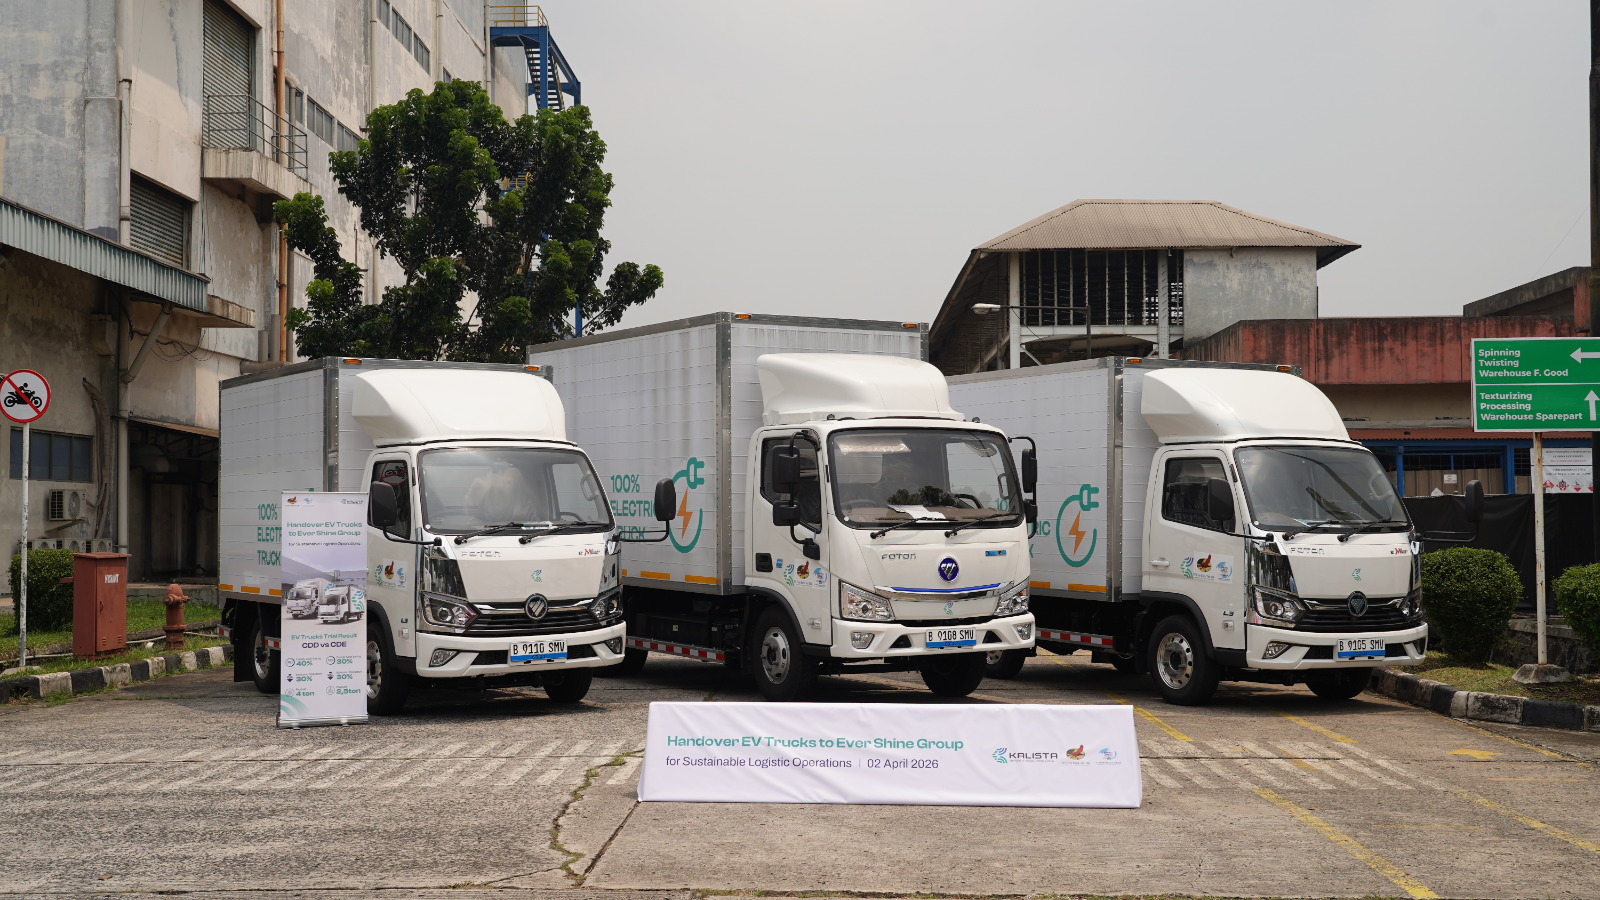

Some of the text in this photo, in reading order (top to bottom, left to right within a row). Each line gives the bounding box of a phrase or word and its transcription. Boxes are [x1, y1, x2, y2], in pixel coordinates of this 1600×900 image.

[1478, 348, 1521, 358] Spinning
[1478, 358, 1519, 368] Twisting
[1479, 368, 1569, 377] Warehouse F. Good
[1479, 392, 1533, 401] Texturizing
[1480, 402, 1532, 411] Processing
[1481, 412, 1583, 421] Warehouse Sparepart
[610, 474, 640, 493] 100%
[257, 503, 278, 520] 100%
[617, 525, 646, 540] RUCK
[257, 549, 281, 566] TRUCK
[461, 550, 501, 558] FOTON
[881, 552, 917, 560] FOTON
[928, 629, 974, 642] B 9108 SMV
[513, 641, 565, 655] B 9110 SMV
[1339, 638, 1384, 651] B 9105 SMV
[667, 735, 964, 752] Handover EV Trucks to Ever Shine Group
[1008, 752, 1059, 760] KALISTA
[666, 755, 939, 770] for Sustainable Logistic Operations 02 April 2026
